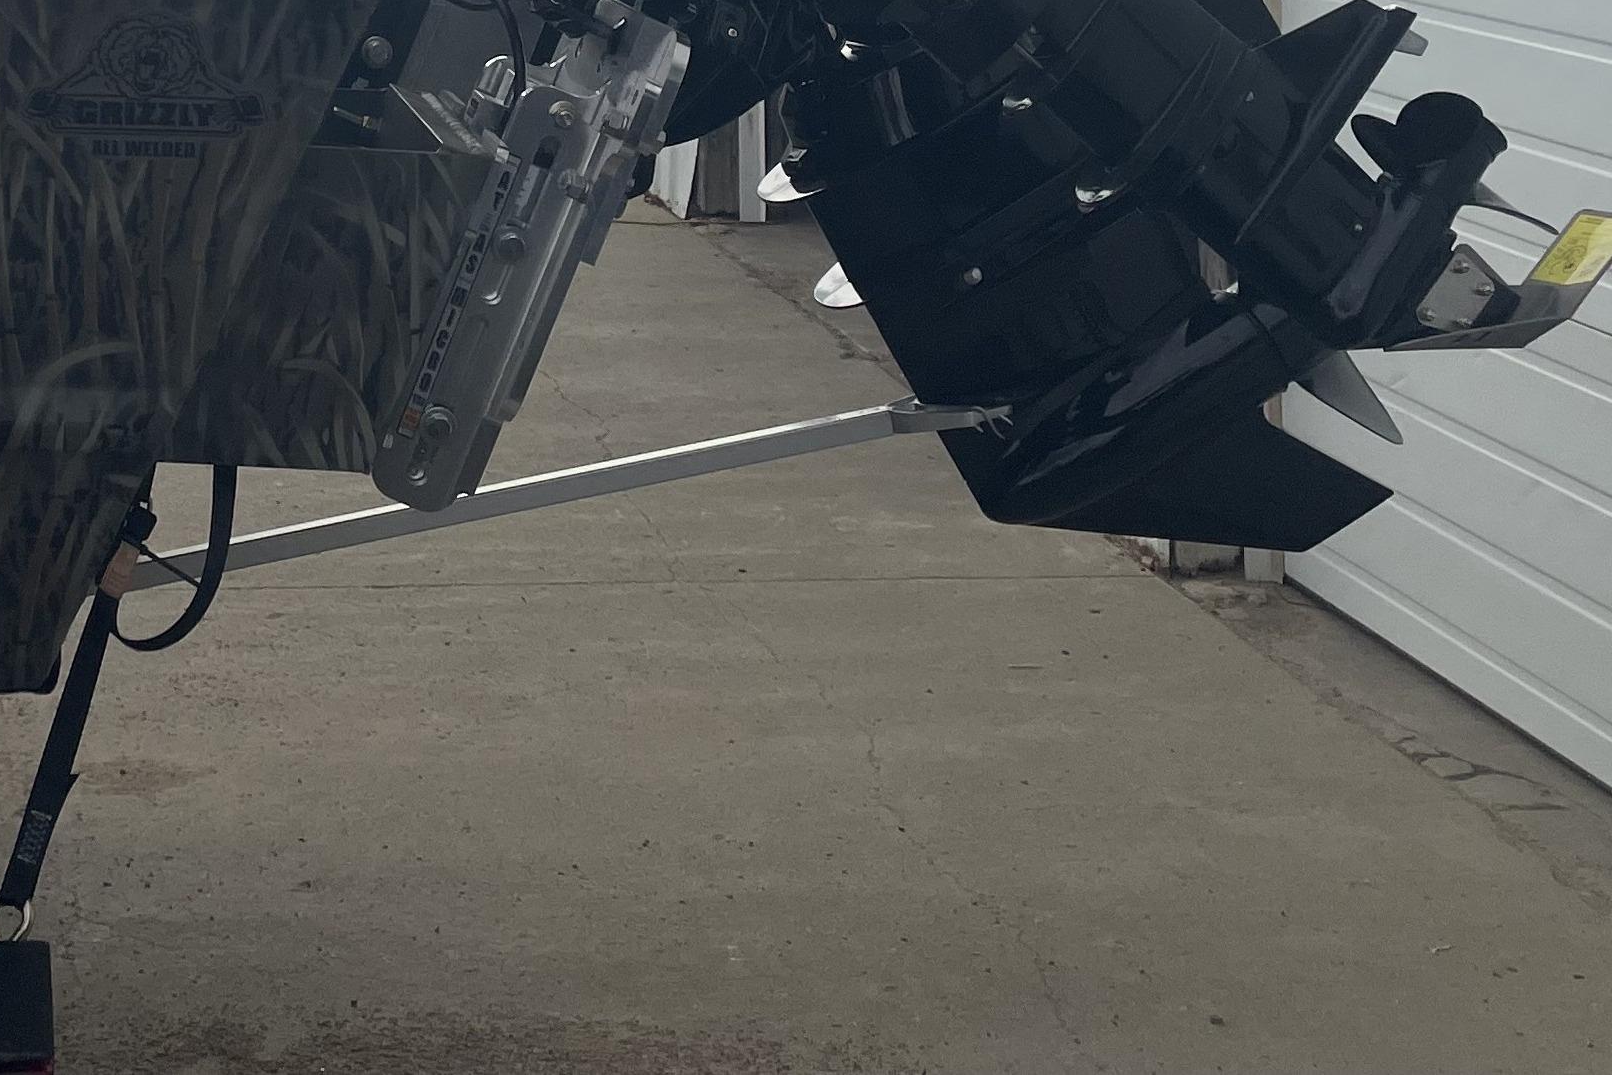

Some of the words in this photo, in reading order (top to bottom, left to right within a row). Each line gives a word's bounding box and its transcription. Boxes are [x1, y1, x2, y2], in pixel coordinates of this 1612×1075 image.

[70, 100, 216, 127] GRIZZLY
[91, 139, 120, 157] ALL
[124, 140, 197, 158] WELDED
